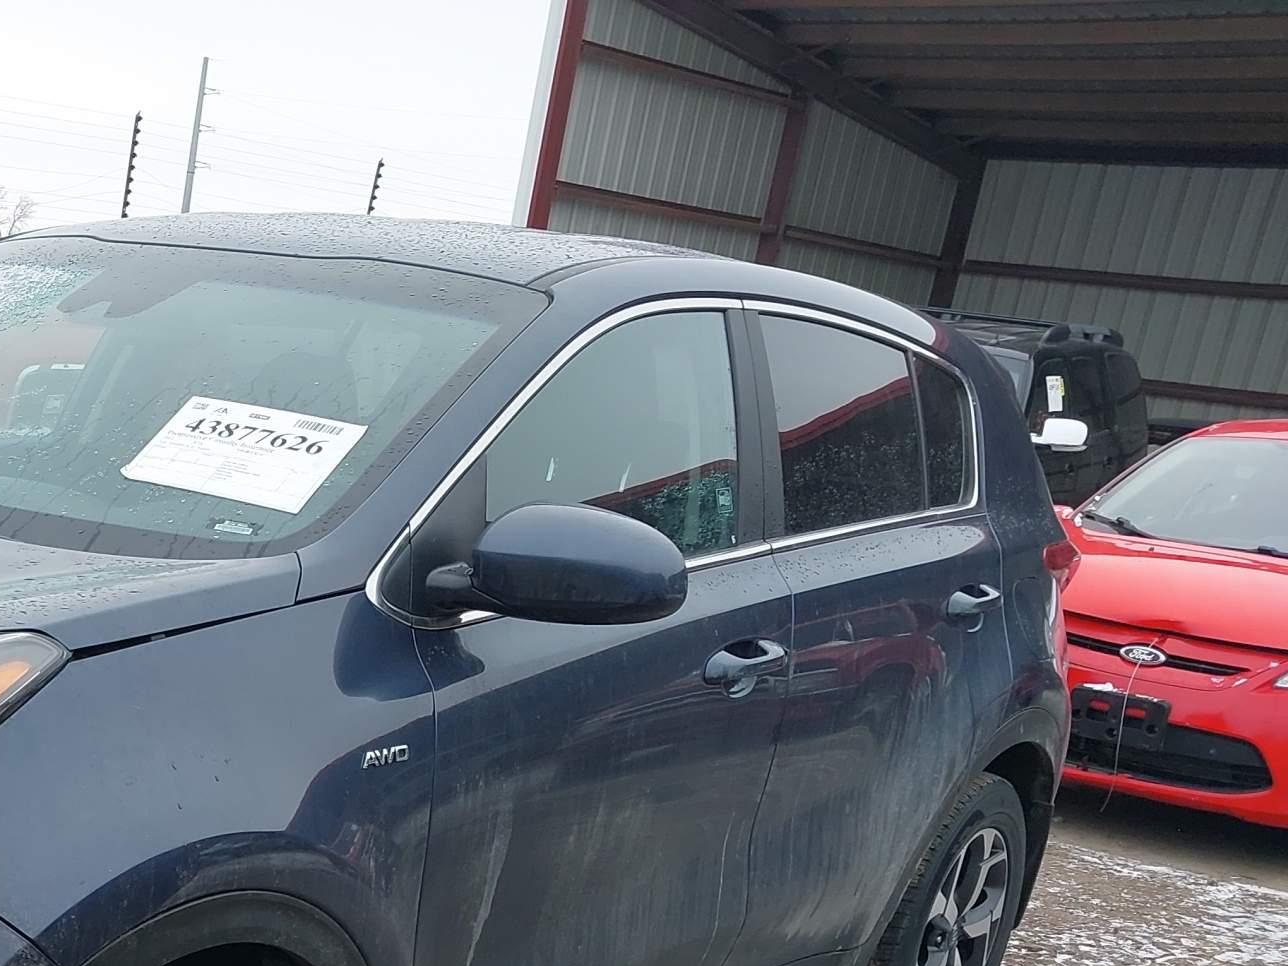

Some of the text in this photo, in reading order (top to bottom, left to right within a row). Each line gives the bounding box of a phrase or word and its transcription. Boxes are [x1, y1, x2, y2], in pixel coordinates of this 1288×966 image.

[185, 417, 329, 456] 43877626
[1128, 648, 1155, 661] Ford
[363, 744, 409, 769] AWD
